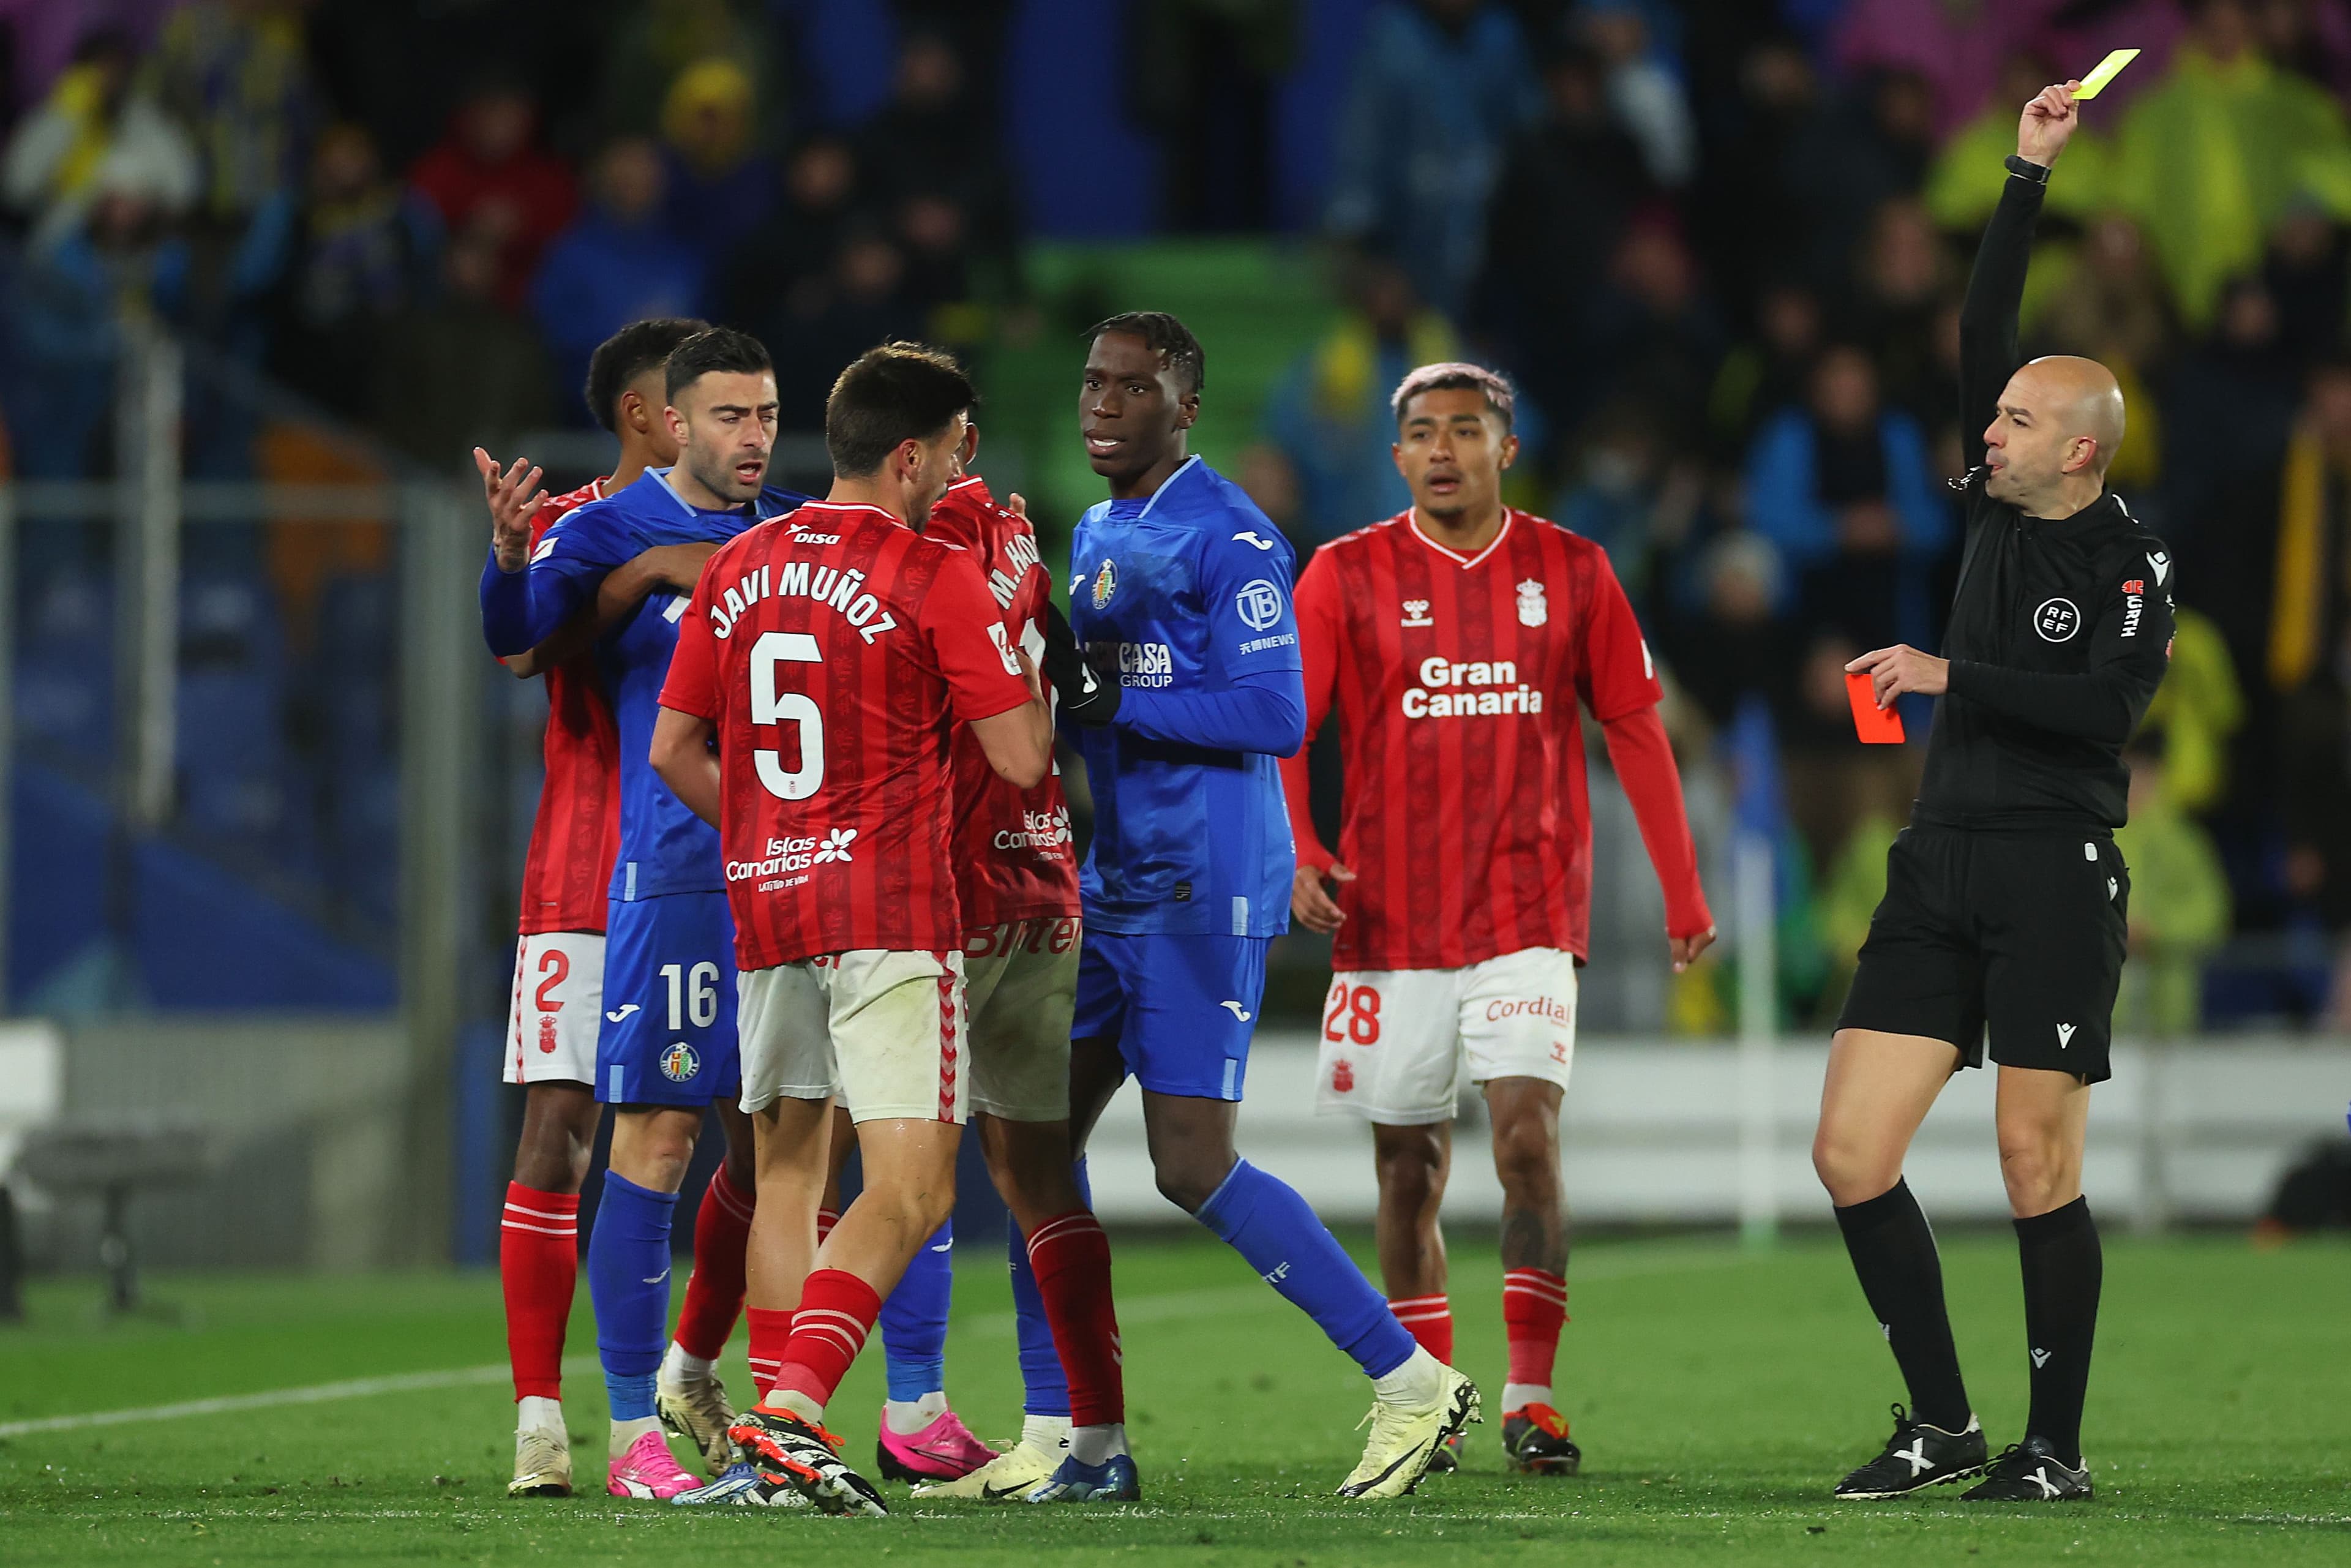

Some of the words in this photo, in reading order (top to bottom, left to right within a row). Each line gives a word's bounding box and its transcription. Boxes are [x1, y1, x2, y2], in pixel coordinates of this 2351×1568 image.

[710, 565, 771, 639] JAVI
[778, 562, 898, 645] MUÑOZ
[2047, 606, 2074, 621] RF
[2042, 618, 2069, 632] EF
[1120, 675, 1174, 688] GROUP
[1419, 656, 1517, 688] Gran
[749, 631, 825, 800] 5
[1401, 683, 1543, 719] Canaria
[765, 836, 817, 857] Islas
[726, 852, 812, 882] Canarias
[535, 949, 569, 1012] 2
[659, 961, 720, 1030] 16
[1325, 981, 1381, 1046] 28
[1486, 995, 1570, 1022] Cordial
